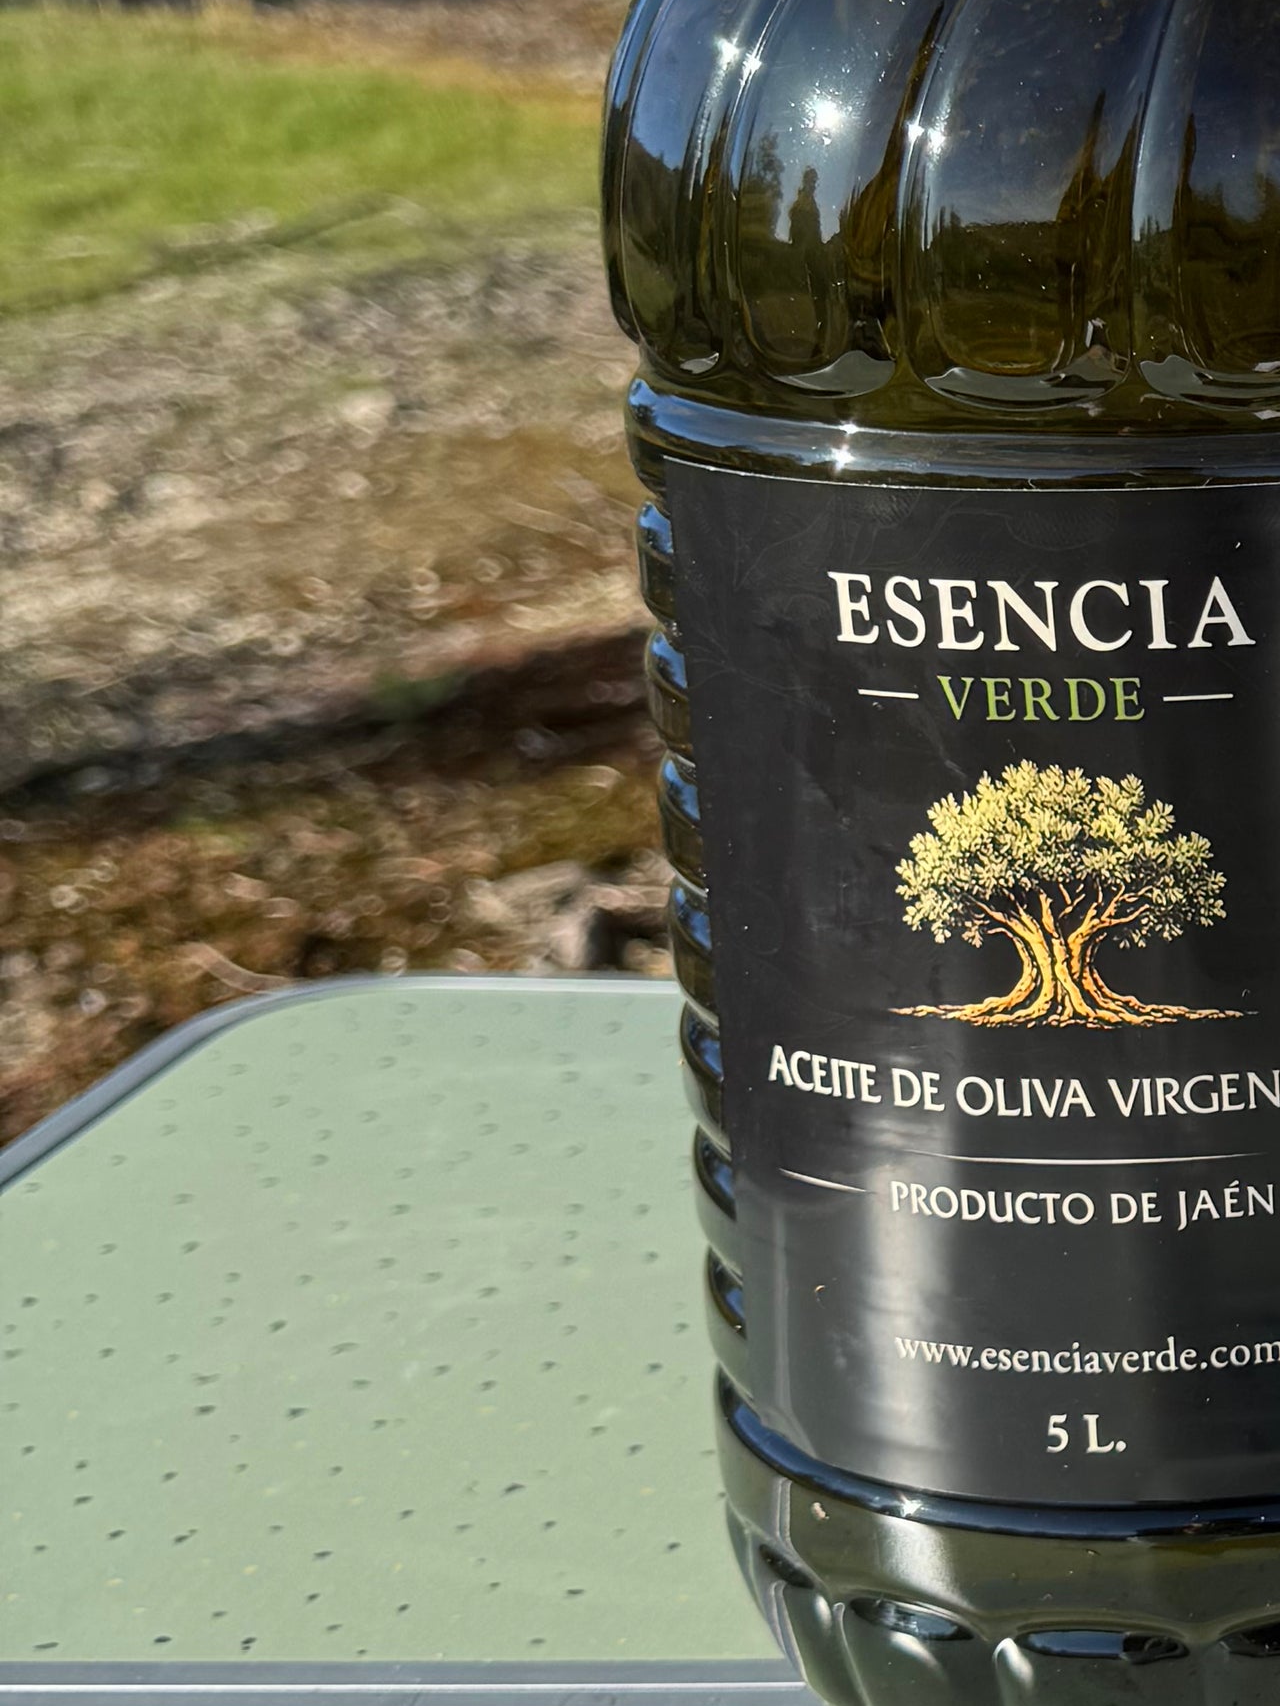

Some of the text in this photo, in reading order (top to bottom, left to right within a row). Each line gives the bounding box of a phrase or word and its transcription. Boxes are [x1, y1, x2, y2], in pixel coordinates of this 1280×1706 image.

[826, 570, 1258, 653] ESENCIA
[935, 673, 1147, 723] VERDE
[767, 1043, 883, 1105] ACEITE
[890, 1066, 948, 1113] DE
[954, 1075, 1097, 1120] OLIVA
[889, 1178, 1276, 1232] PRODUCTO DE JAÉN
[1046, 1412, 1128, 1455] 5 L.
